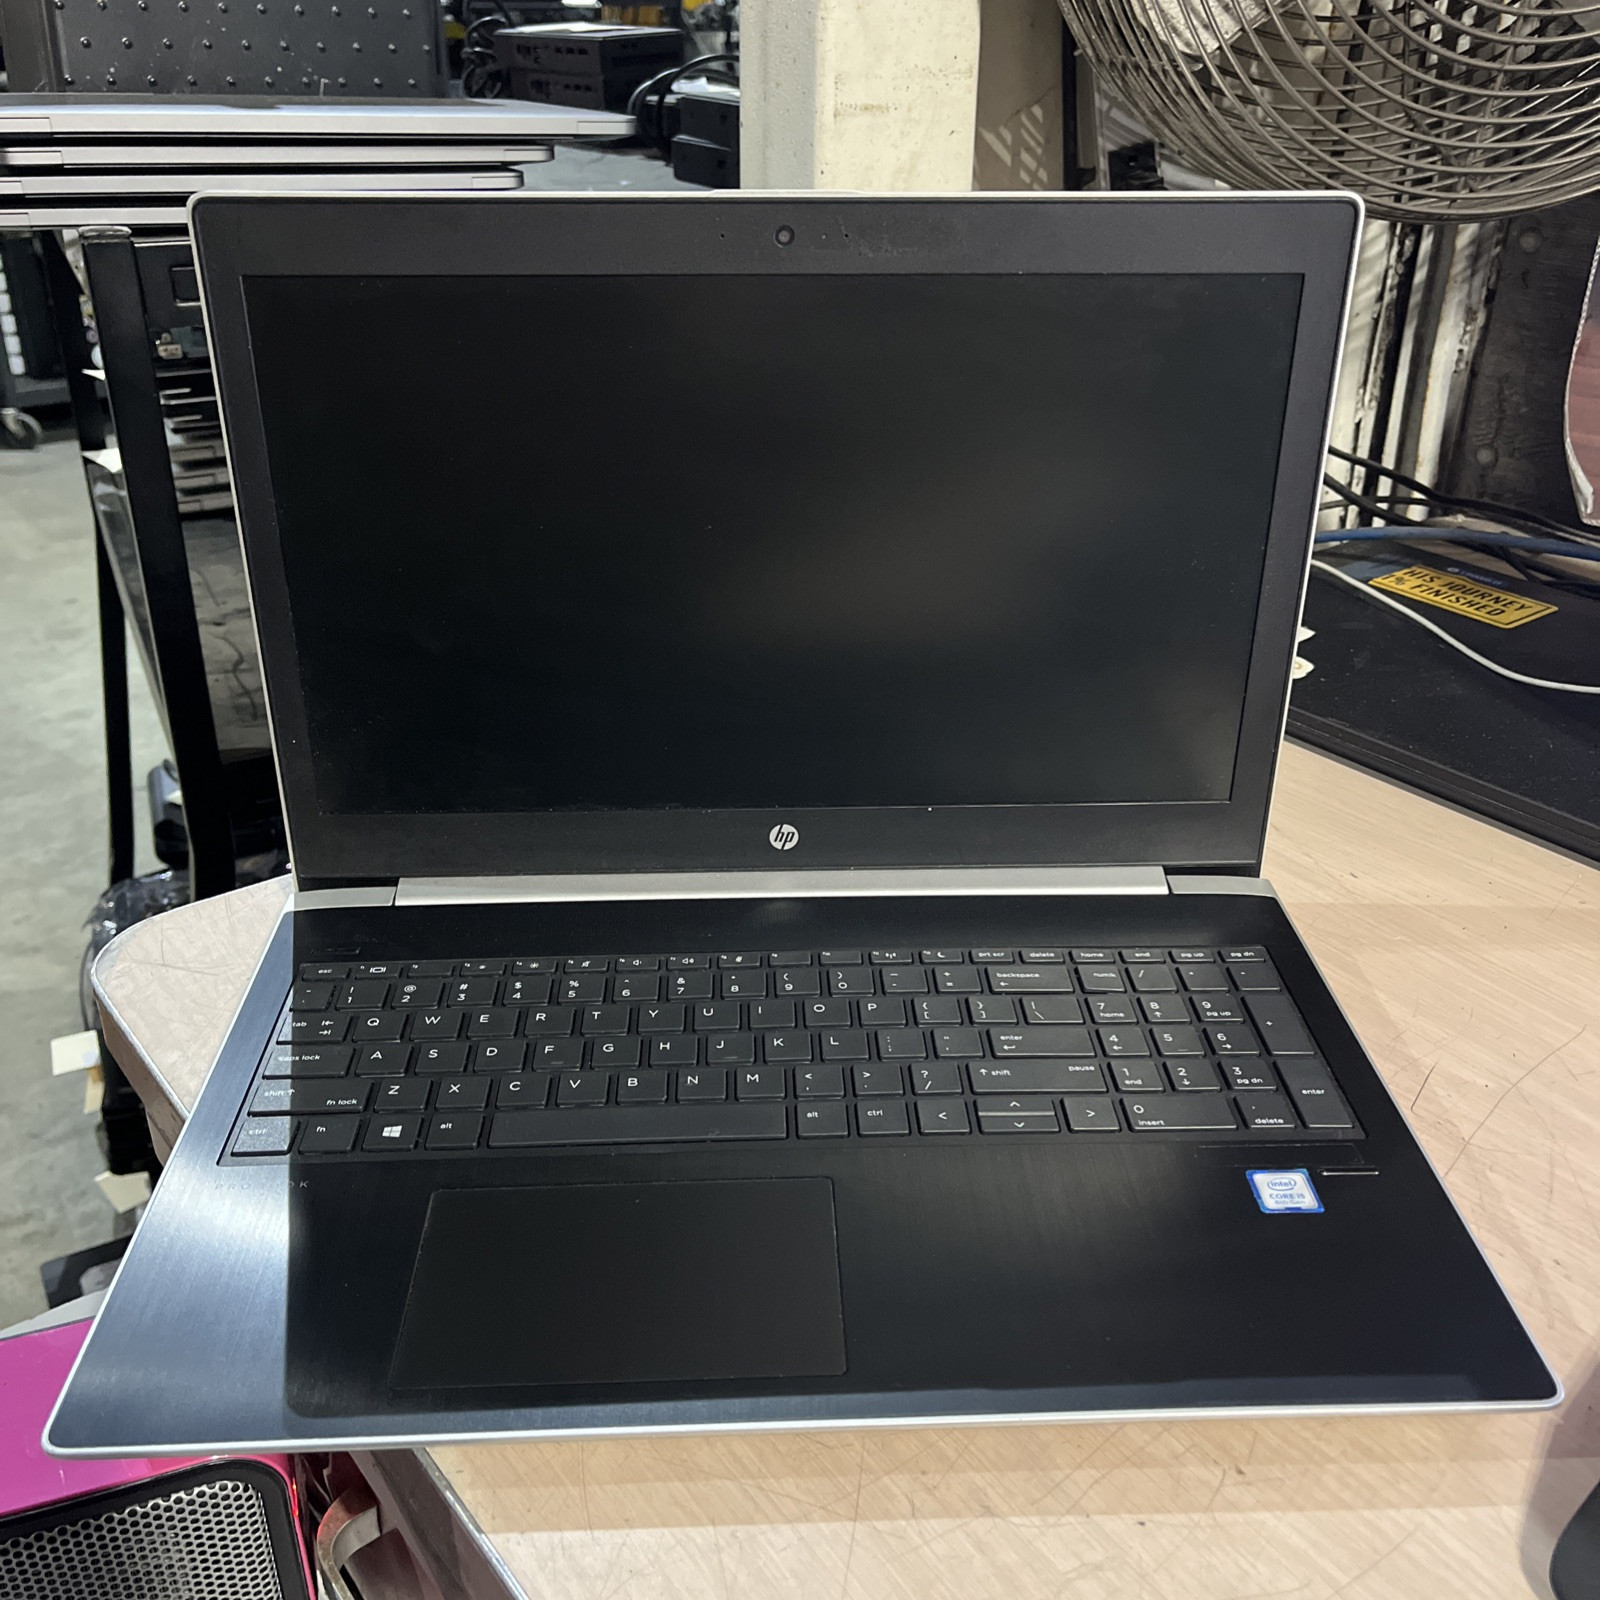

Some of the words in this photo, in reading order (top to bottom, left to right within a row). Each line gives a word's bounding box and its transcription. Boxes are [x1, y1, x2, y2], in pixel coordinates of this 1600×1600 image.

[1409, 583, 1506, 617] FINISHED
[1438, 581, 1533, 611] JOURNEY
[769, 824, 799, 850] hp
[783, 973, 789, 981] (
[837, 971, 843, 980] )
[514, 981, 522, 990] $
[568, 980, 580, 988] %
[676, 977, 686, 985] &
[403, 984, 417, 993] @
[677, 987, 685, 995] 7
[730, 985, 739, 993] 8
[784, 983, 794, 991] 9
[457, 993, 466, 1001] 3
[512, 991, 522, 1000] 4
[567, 990, 576, 998] 5
[621, 989, 631, 997] 6
[347, 996, 353, 1004] 1
[401, 995, 411, 1003] 2
[813, 1004, 826, 1013] O
[867, 1003, 877, 1011] P
[1096, 1002, 1105, 1010] 7
[1149, 1001, 1160, 1010] 8
[1201, 1001, 1212, 1009] 9
[648, 1009, 659, 1018] Y
[703, 1007, 714, 1017] U
[758, 1006, 762, 1014] I
[979, 1010, 987, 1019] ]
[479, 1014, 490, 1023] E
[535, 1012, 547, 1021] R
[591, 1011, 602, 1020] T
[923, 1011, 930, 1020] [
[291, 1020, 308, 1029] tab
[366, 1017, 380, 1027] Q
[424, 1016, 442, 1025] W
[830, 1036, 840, 1045] L
[1109, 1034, 1119, 1043] 4
[1163, 1033, 1173, 1042] 5
[1216, 1032, 1227, 1041] 6
[659, 1041, 671, 1051] H
[716, 1040, 725, 1049] J
[773, 1038, 784, 1047] K
[486, 1047, 498, 1056] D
[544, 1045, 555, 1054] F
[602, 1043, 614, 1053] G
[370, 1050, 383, 1060] A
[428, 1049, 439, 1059] S
[920, 1070, 929, 1079] ?
[1121, 1067, 1130, 1077] 1
[1176, 1067, 1188, 1076] 2
[1232, 1066, 1242, 1076] 3
[627, 1077, 639, 1087] B
[687, 1075, 699, 1085] N
[746, 1073, 759, 1083] M
[448, 1083, 461, 1093] X
[509, 1081, 521, 1091] C
[569, 1079, 581, 1089] V
[924, 1080, 932, 1091] /
[263, 1088, 286, 1098] shift
[388, 1085, 400, 1095] Z
[867, 1109, 883, 1117] ctrl
[247, 1127, 267, 1137] ctrl
[214, 1180, 309, 1191] PROOK
[1270, 1180, 1293, 1188] intel
[1269, 1192, 1293, 1200] CORE
